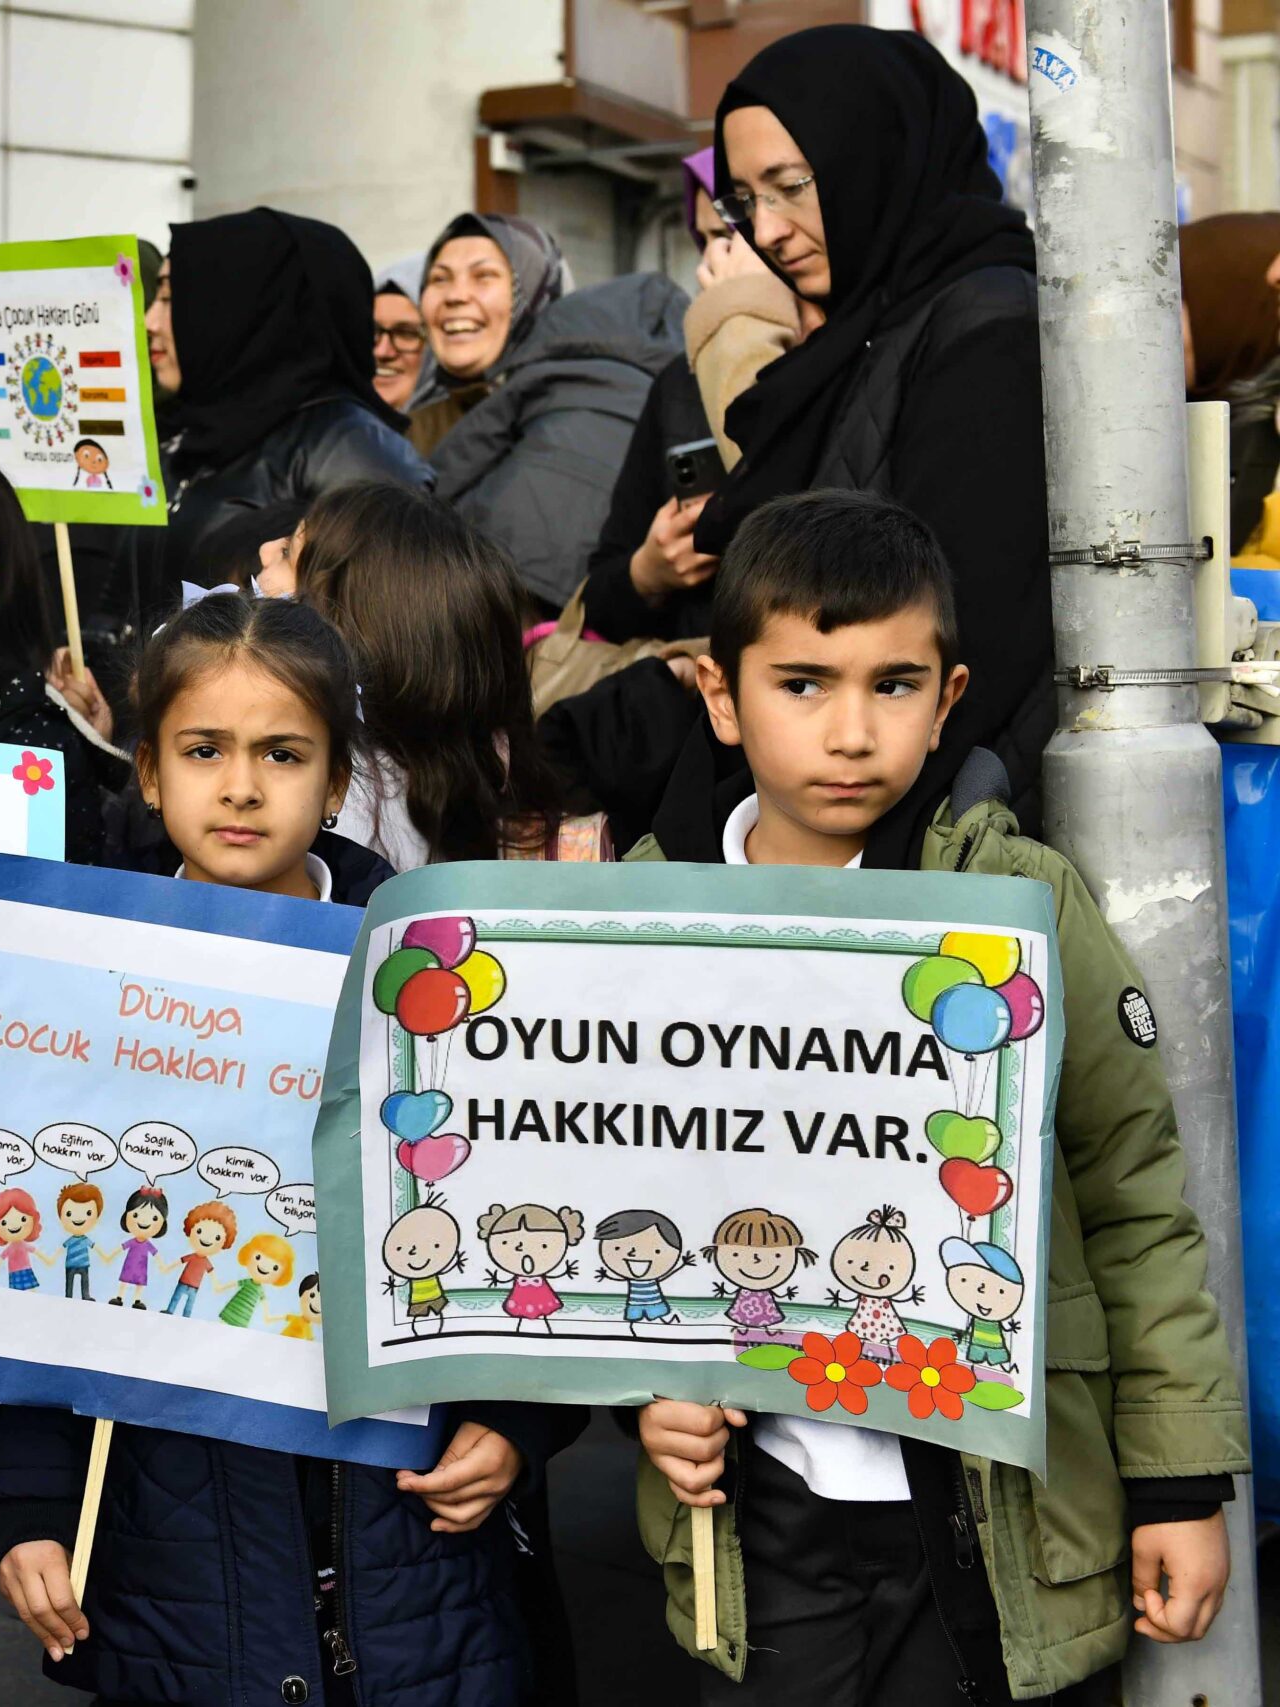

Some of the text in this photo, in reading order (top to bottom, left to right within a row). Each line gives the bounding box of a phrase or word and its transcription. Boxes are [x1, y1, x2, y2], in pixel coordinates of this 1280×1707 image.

[4, 306, 34, 334] Çocuk
[37, 304, 71, 326] Hakları
[73, 302, 100, 327] Günü
[119, 984, 242, 1039] Dünya
[465, 1014, 949, 1082] OYUN OYNAMA
[113, 1036, 247, 1089] Hakları
[60, 1133, 94, 1148] Eğitim
[143, 1133, 175, 1148] Sağlık
[468, 1098, 928, 1164] HAKKIMIZ VAR.
[6, 1154, 27, 1167] var.
[42, 1142, 108, 1163] hakkım var.
[125, 1141, 189, 1162] hakkım var.
[206, 1166, 270, 1184] hakkım var.
[275, 1192, 294, 1204] Tüm
